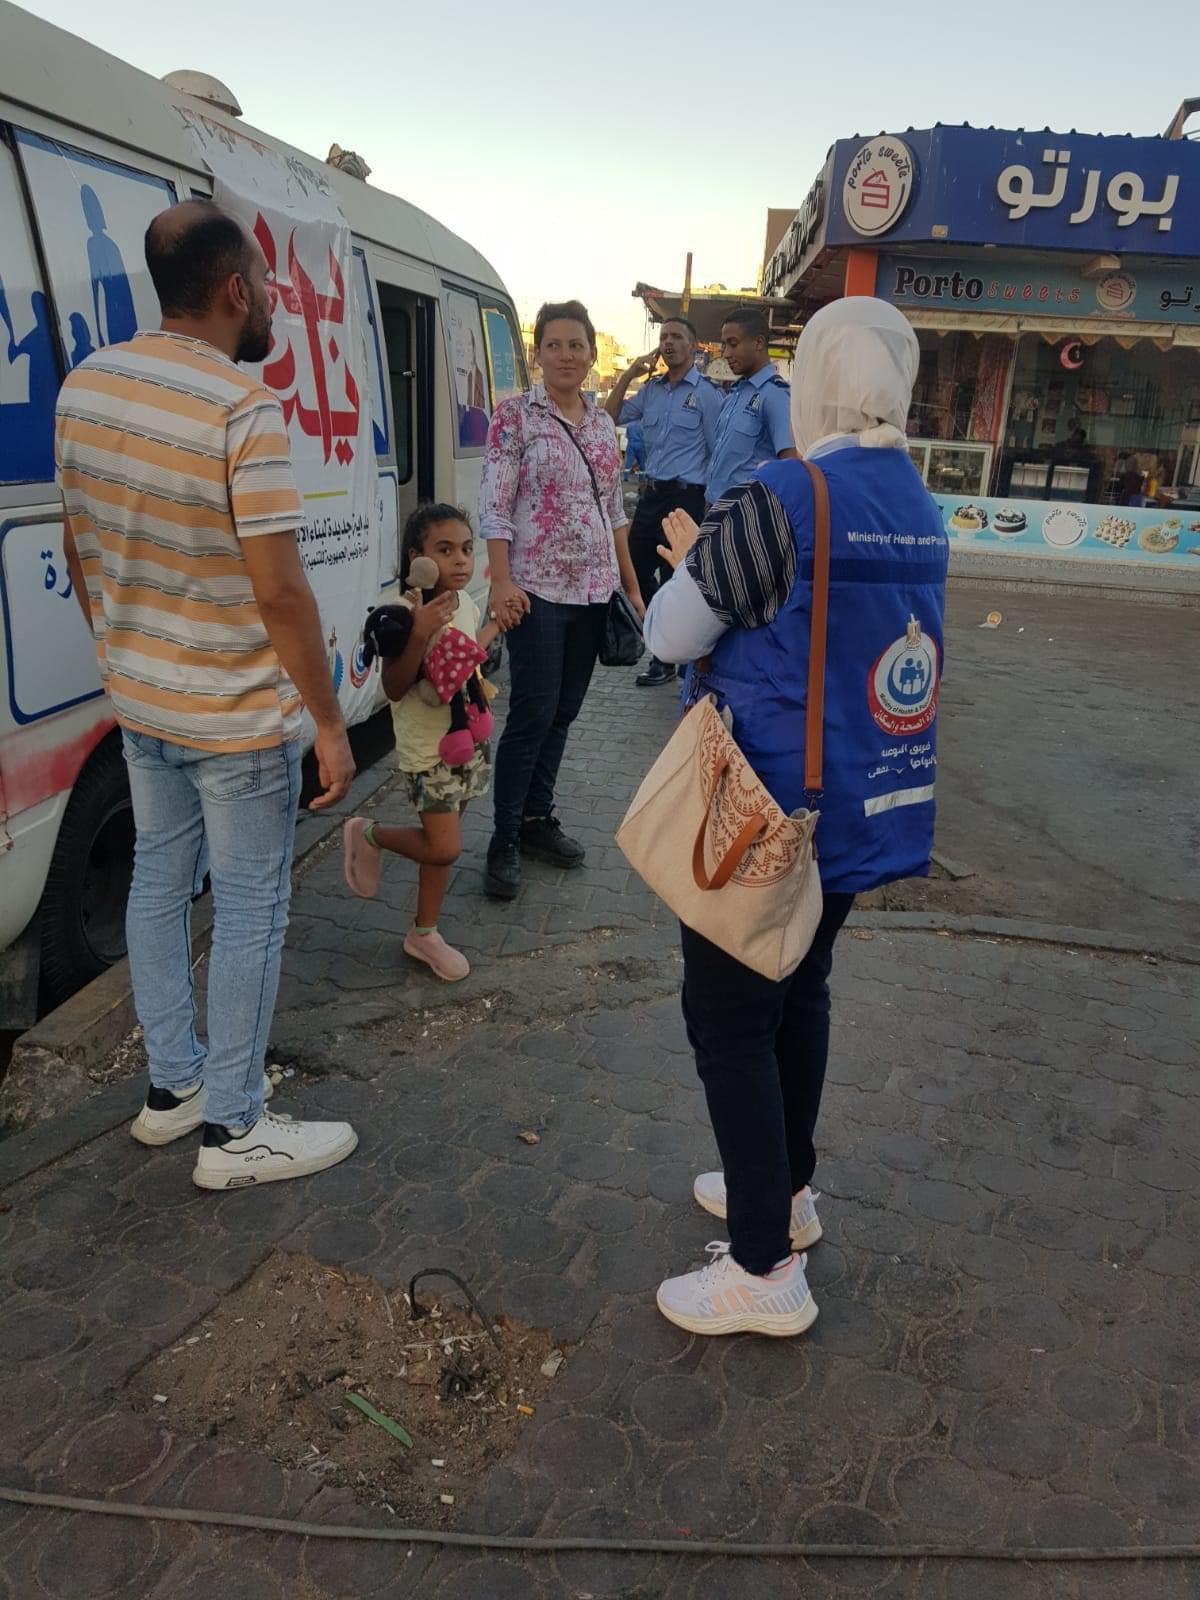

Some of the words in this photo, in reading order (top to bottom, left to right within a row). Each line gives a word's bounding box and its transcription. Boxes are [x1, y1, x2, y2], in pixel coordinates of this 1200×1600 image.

[997, 149, 1180, 232] بورتو
[893, 266, 984, 300] Porto
[987, 281, 1081, 305] sweets
[310, 518, 327, 546] لبناء
[328, 517, 352, 541] جديدة
[848, 532, 885, 545] Ministry
[884, 533, 892, 545] of
[917, 536, 931, 545] and
[873, 709, 899, 733] والسكان
[899, 717, 926, 732] الصحة
